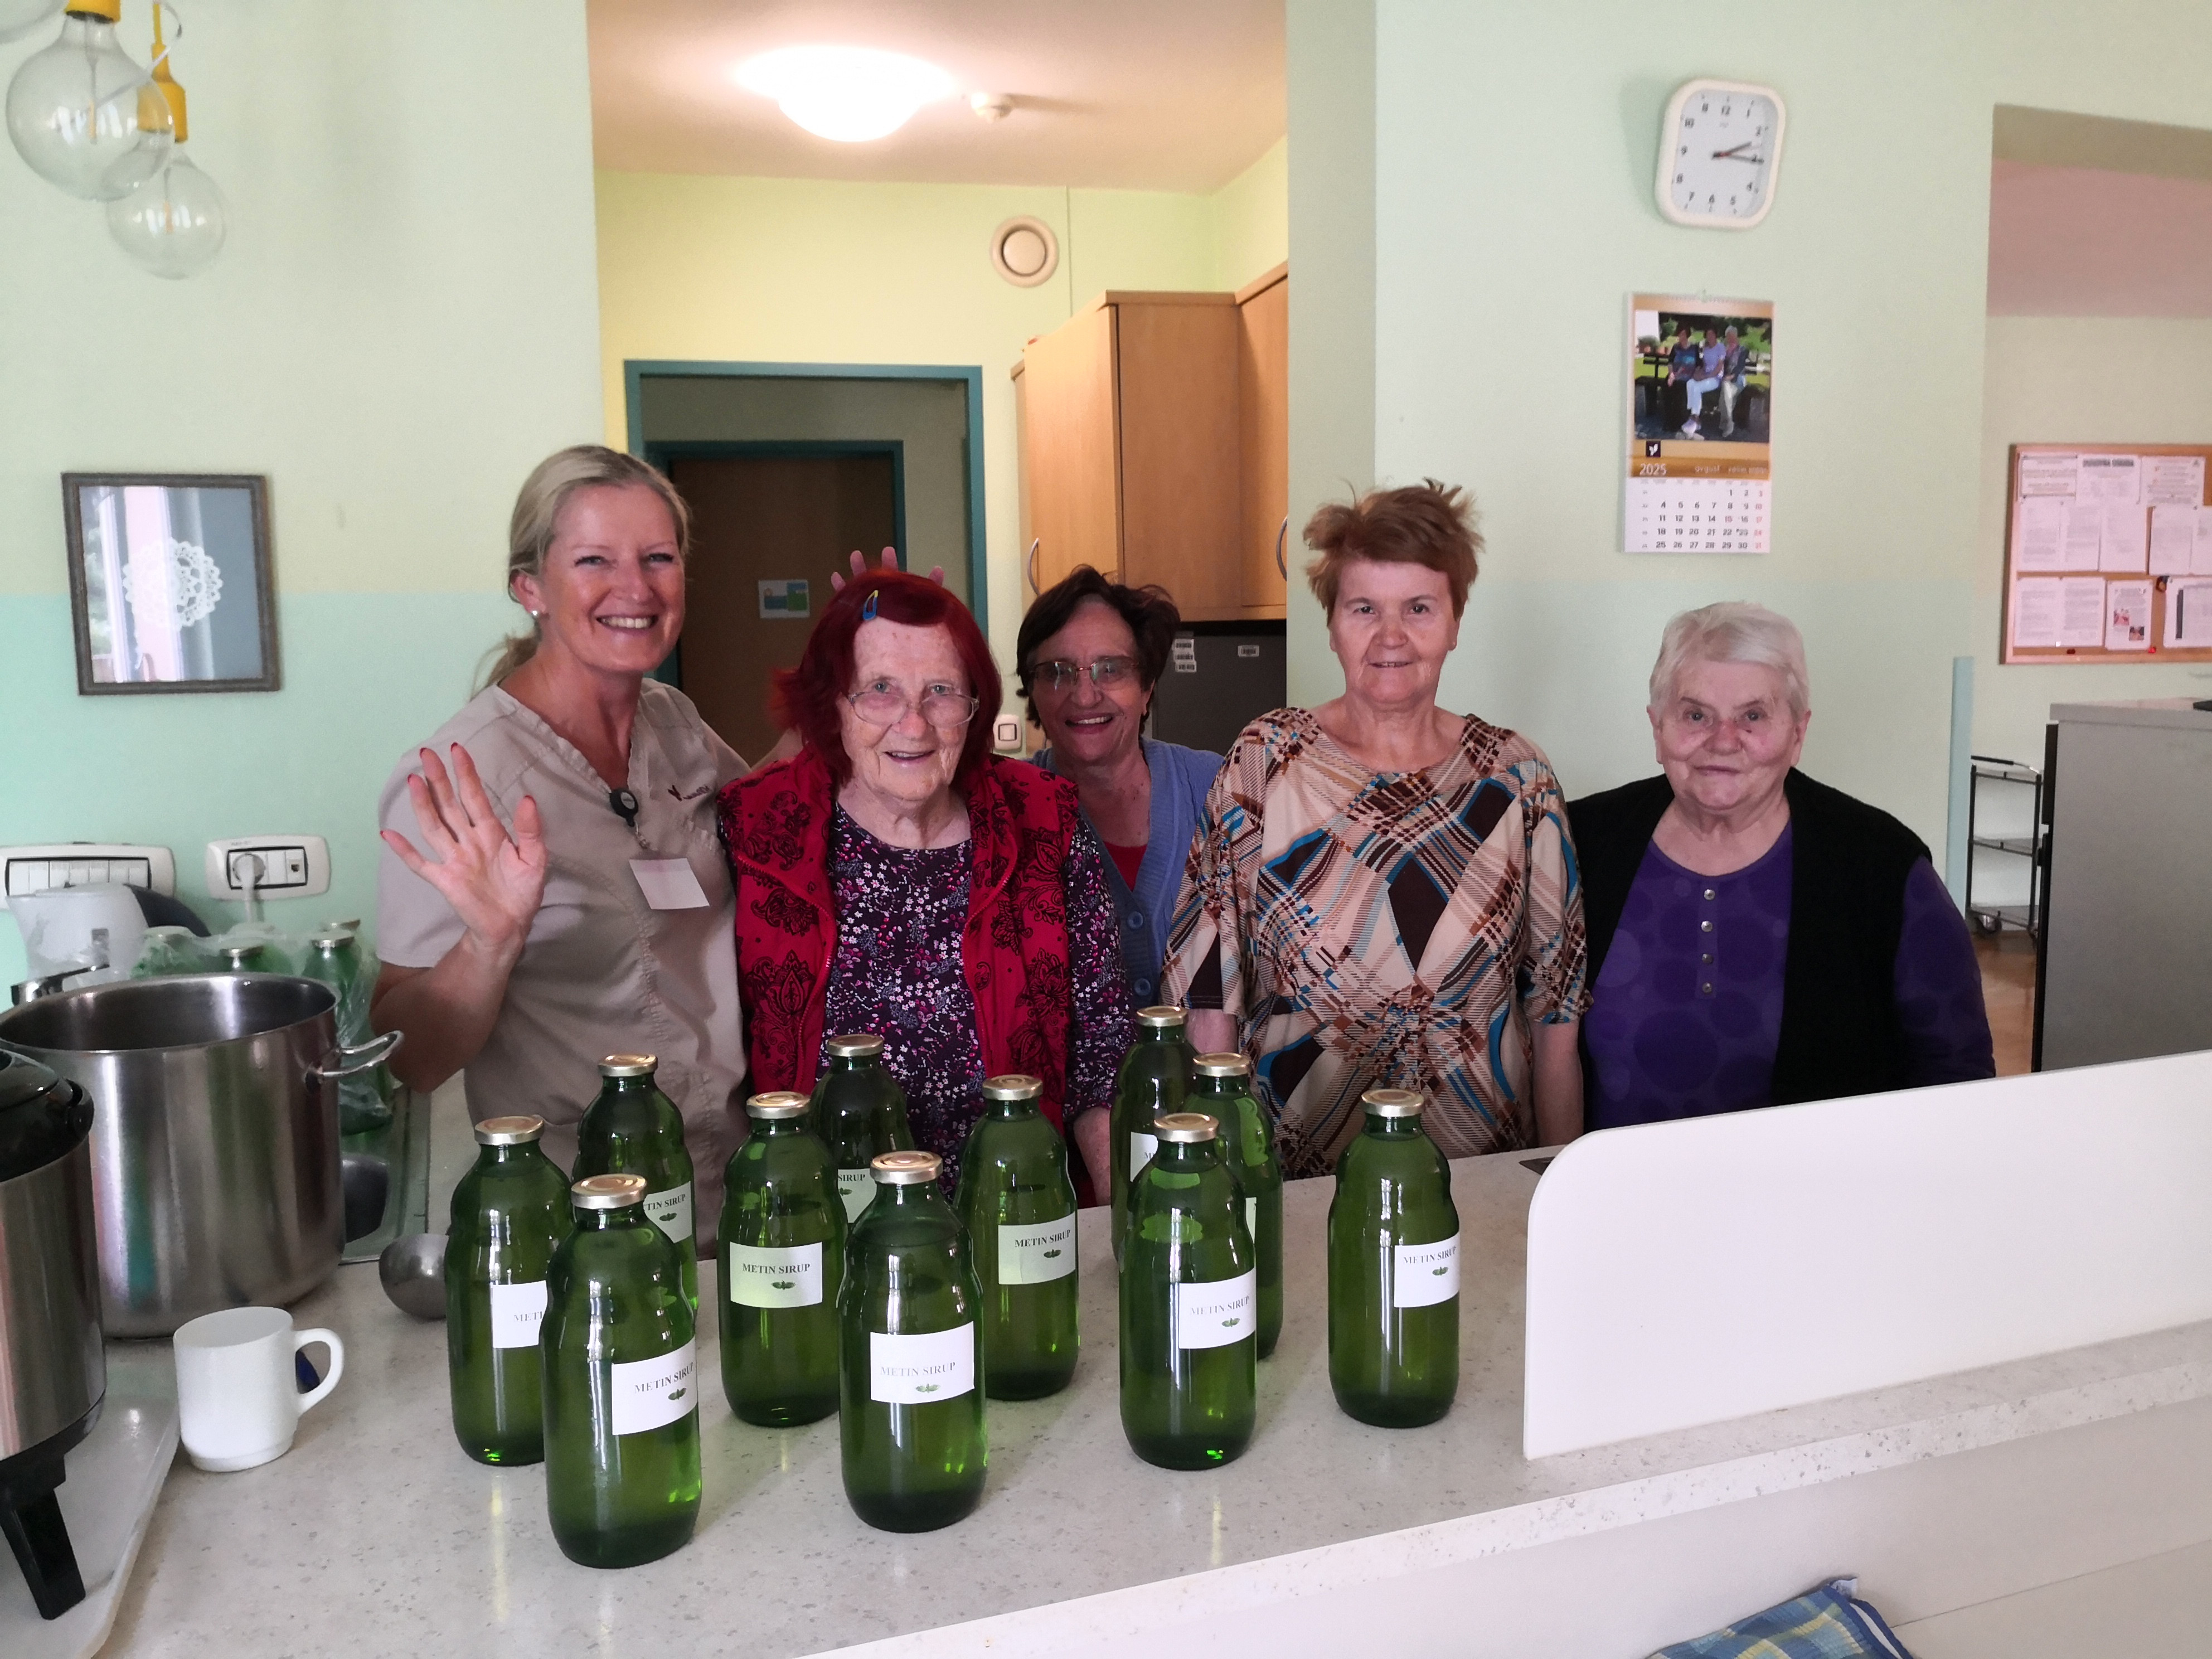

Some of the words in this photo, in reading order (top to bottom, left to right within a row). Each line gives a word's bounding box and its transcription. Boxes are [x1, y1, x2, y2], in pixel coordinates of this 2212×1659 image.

[1639, 463, 1667, 476] 2025
[837, 1173, 866, 1182] SIRUP
[644, 1201, 662, 1211] TIN
[664, 1194, 686, 1207] SIRUP
[1015, 1236, 1047, 1248] METIN
[1049, 1229, 1071, 1244] SIRUP
[1403, 1254, 1435, 1264] METIN
[742, 1263, 776, 1274] METIN
[778, 1263, 811, 1274] SIRUP
[1228, 1295, 1249, 1311] SIRUP
[514, 1311, 542, 1322] METI
[880, 1366, 919, 1377] METIN
[923, 1361, 955, 1375] SIRUP
[634, 1375, 672, 1394] METIN
[673, 1361, 693, 1382] SIRUP
